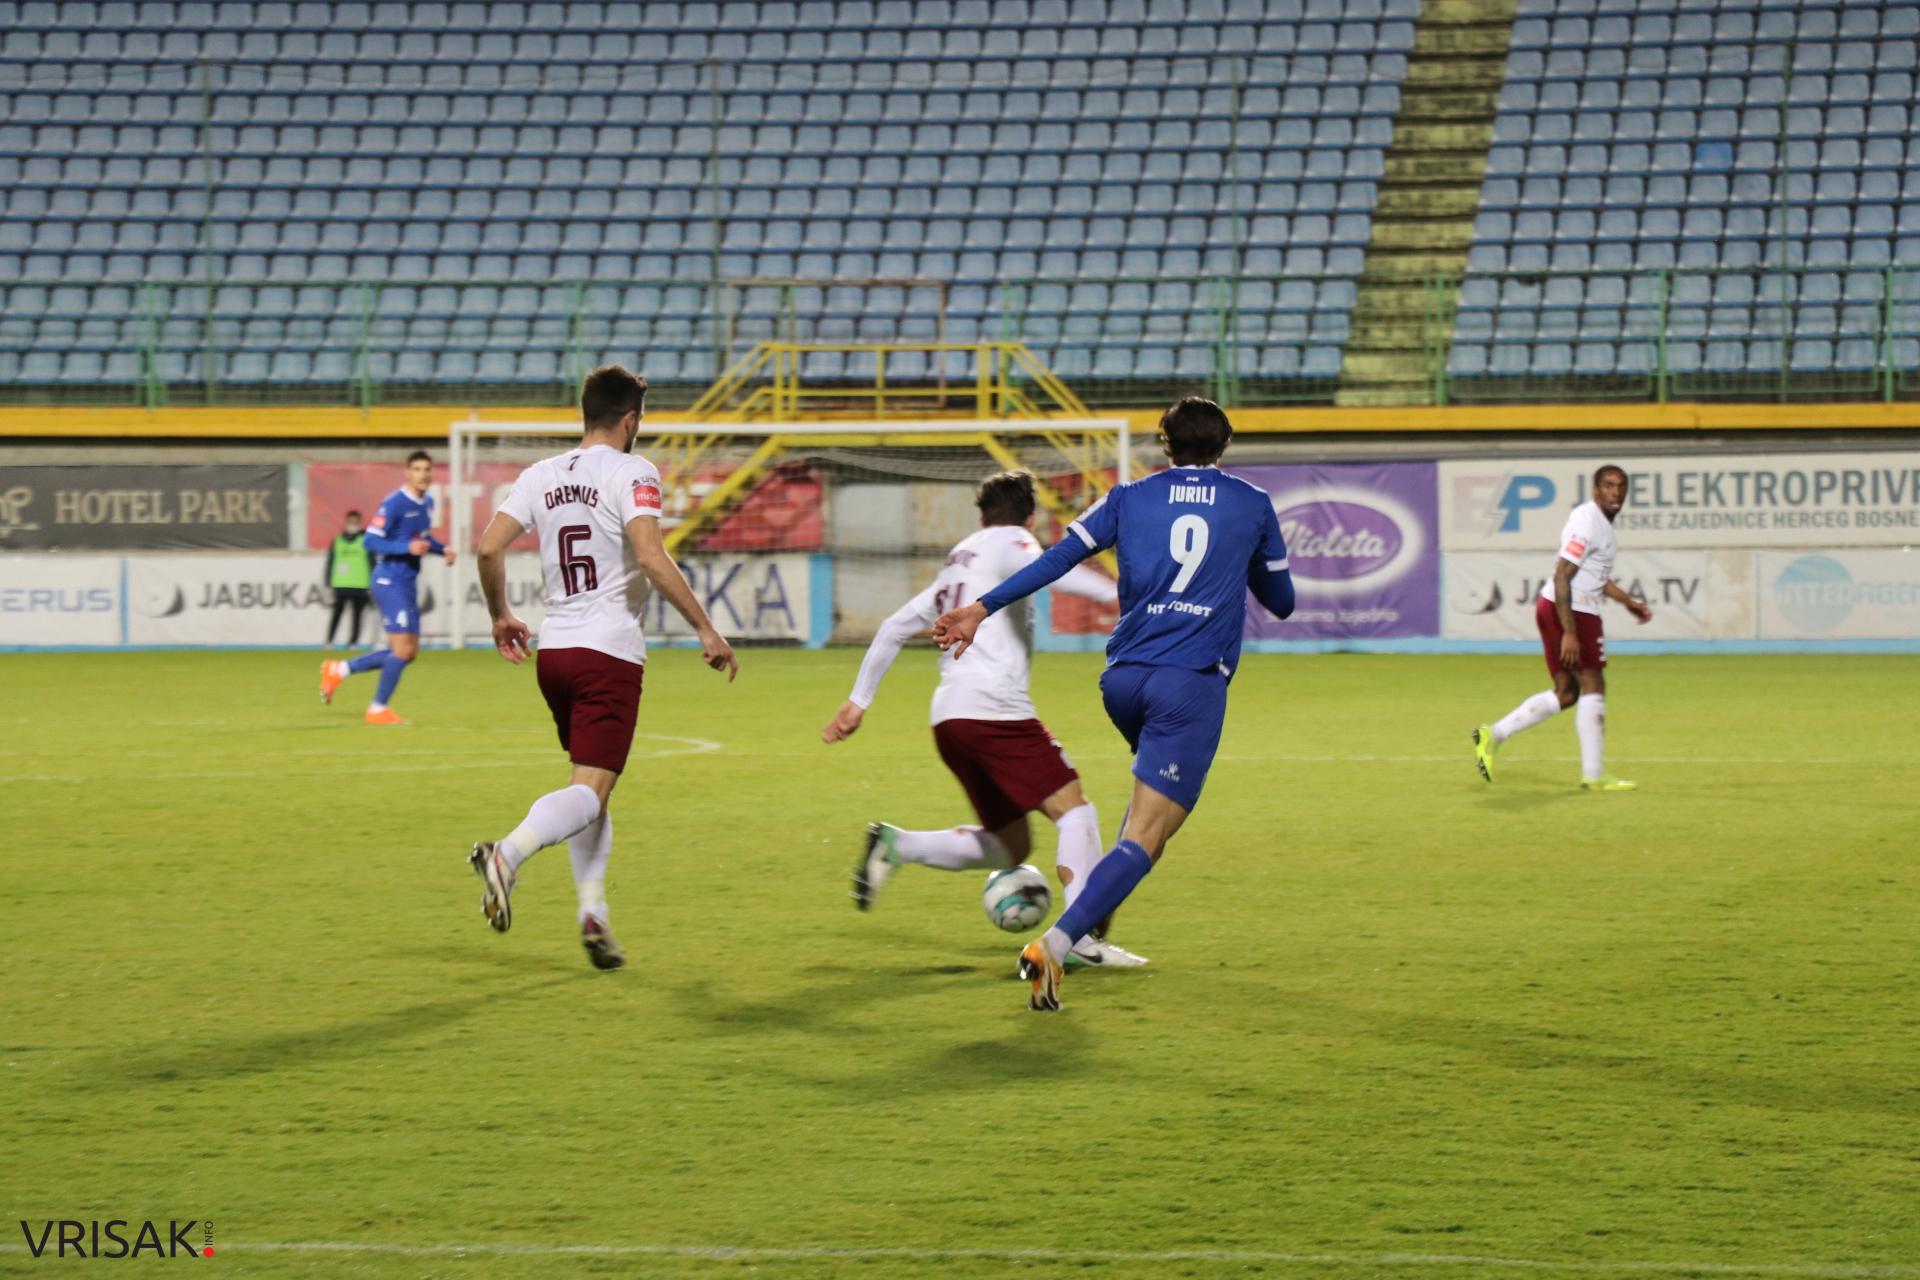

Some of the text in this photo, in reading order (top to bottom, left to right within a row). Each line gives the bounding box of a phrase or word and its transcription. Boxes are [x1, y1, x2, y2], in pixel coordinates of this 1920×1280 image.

[54, 489, 272, 525] HOTEL PARK
[544, 484, 600, 511] OREMUS
[1168, 484, 1216, 506] JURILJ
[1667, 510, 1768, 530] ZAJEDNICE
[1772, 510, 1849, 530] HERCEG
[1855, 508, 1919, 529] BOSNE
[1168, 513, 1210, 593] 9
[1284, 519, 1385, 559] Violeta
[558, 524, 599, 598] 6
